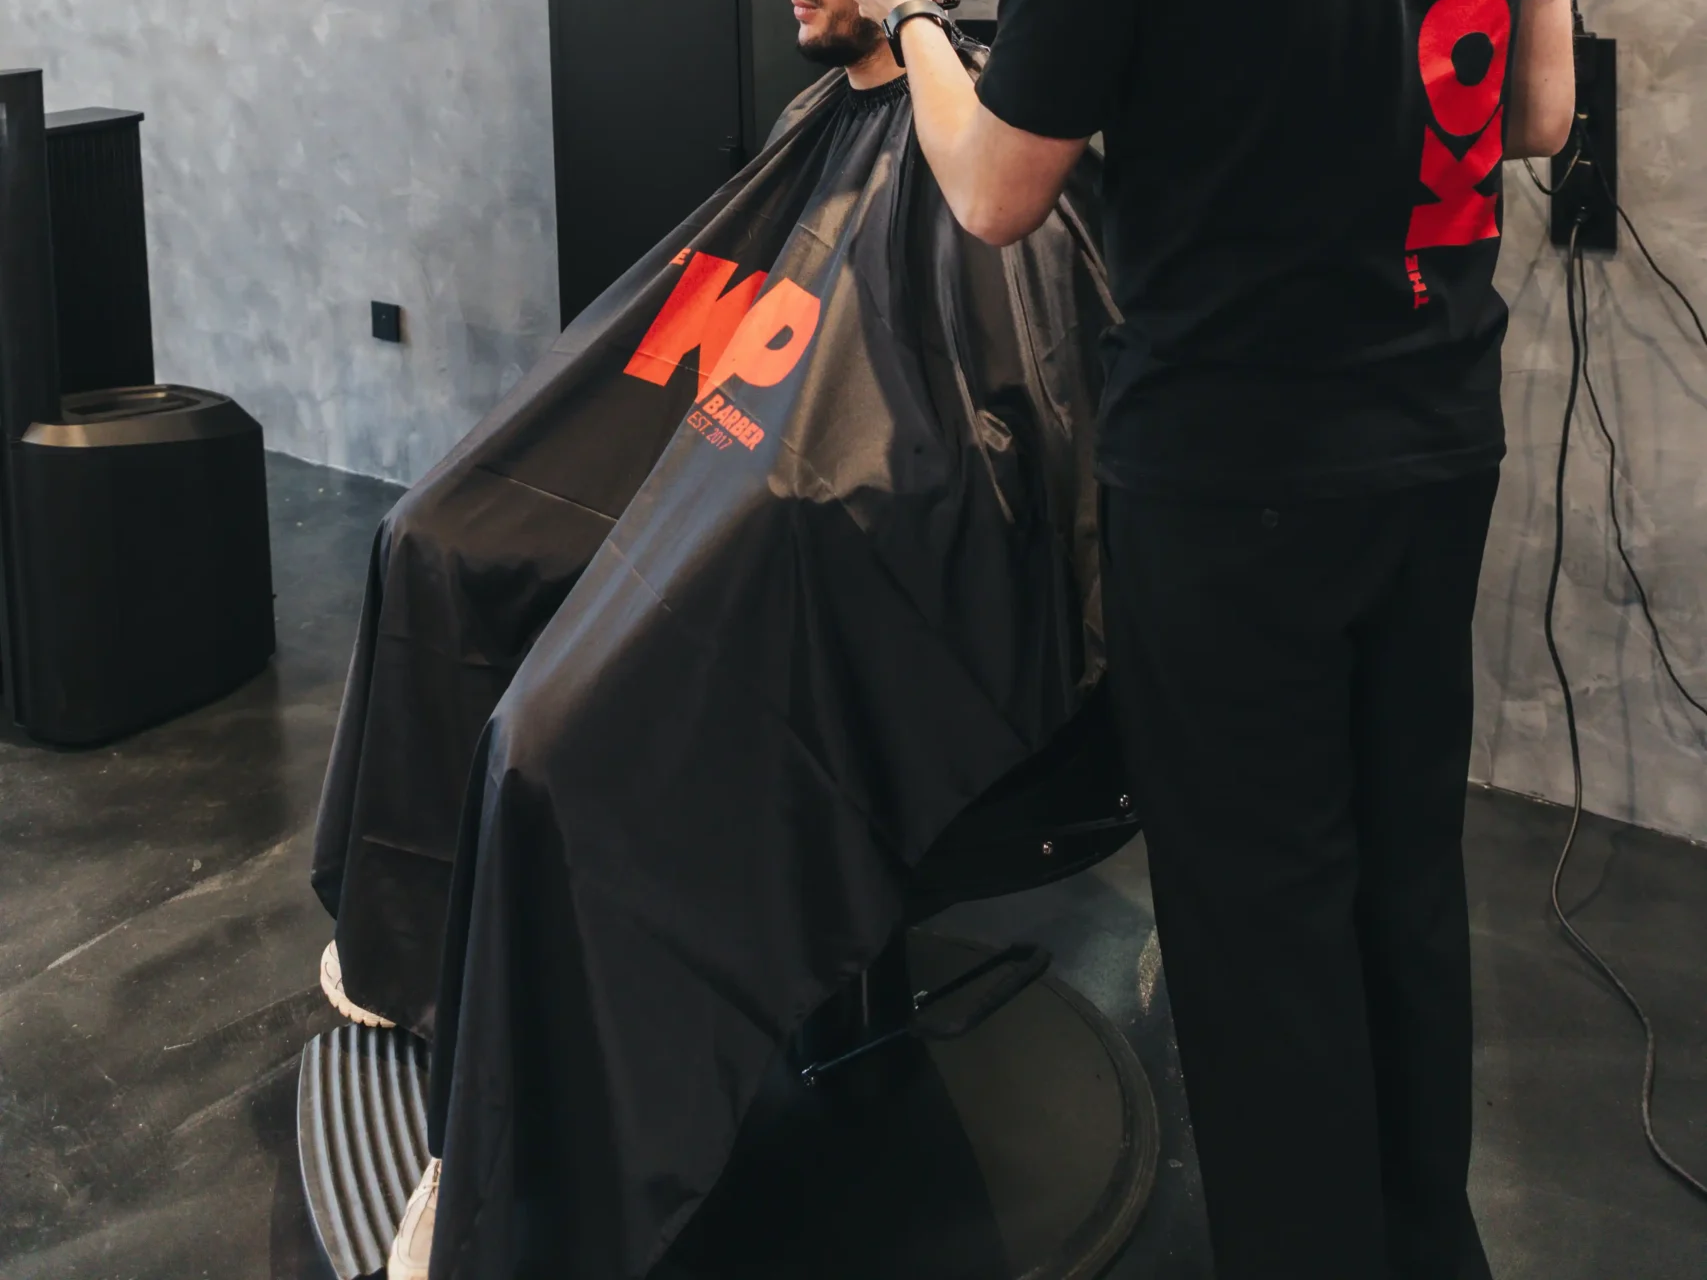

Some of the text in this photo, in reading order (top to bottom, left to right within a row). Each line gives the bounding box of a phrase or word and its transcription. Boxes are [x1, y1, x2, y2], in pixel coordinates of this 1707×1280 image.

[1404, 254, 1429, 309] THE
[686, 410, 734, 450] EST. 2017
[702, 393, 766, 451] BARBER
